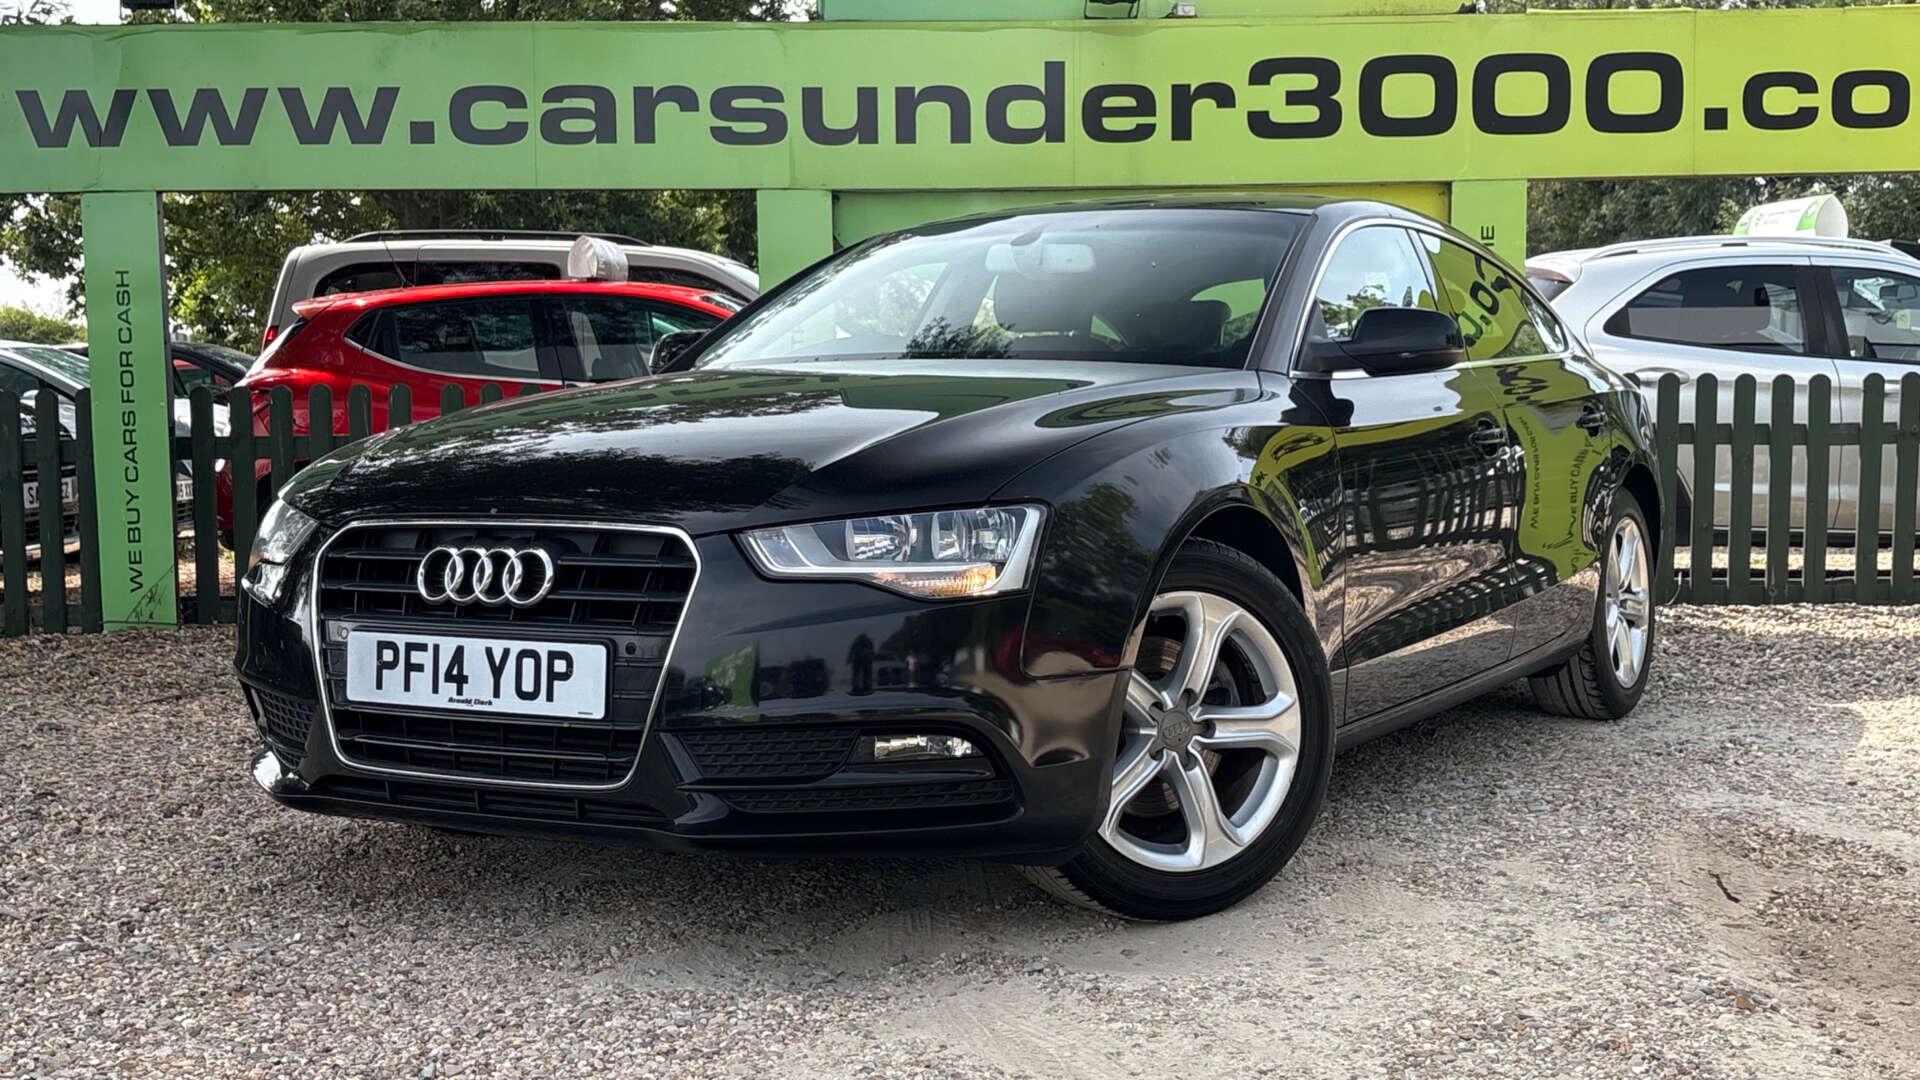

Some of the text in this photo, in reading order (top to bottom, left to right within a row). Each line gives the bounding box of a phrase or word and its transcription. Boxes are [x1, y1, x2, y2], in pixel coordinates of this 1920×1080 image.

[16, 51, 1911, 148] www.carsunder3000.co
[115, 270, 144, 594] WE BUY CARS FOR CASH
[375, 640, 575, 703] PF14 YOP
